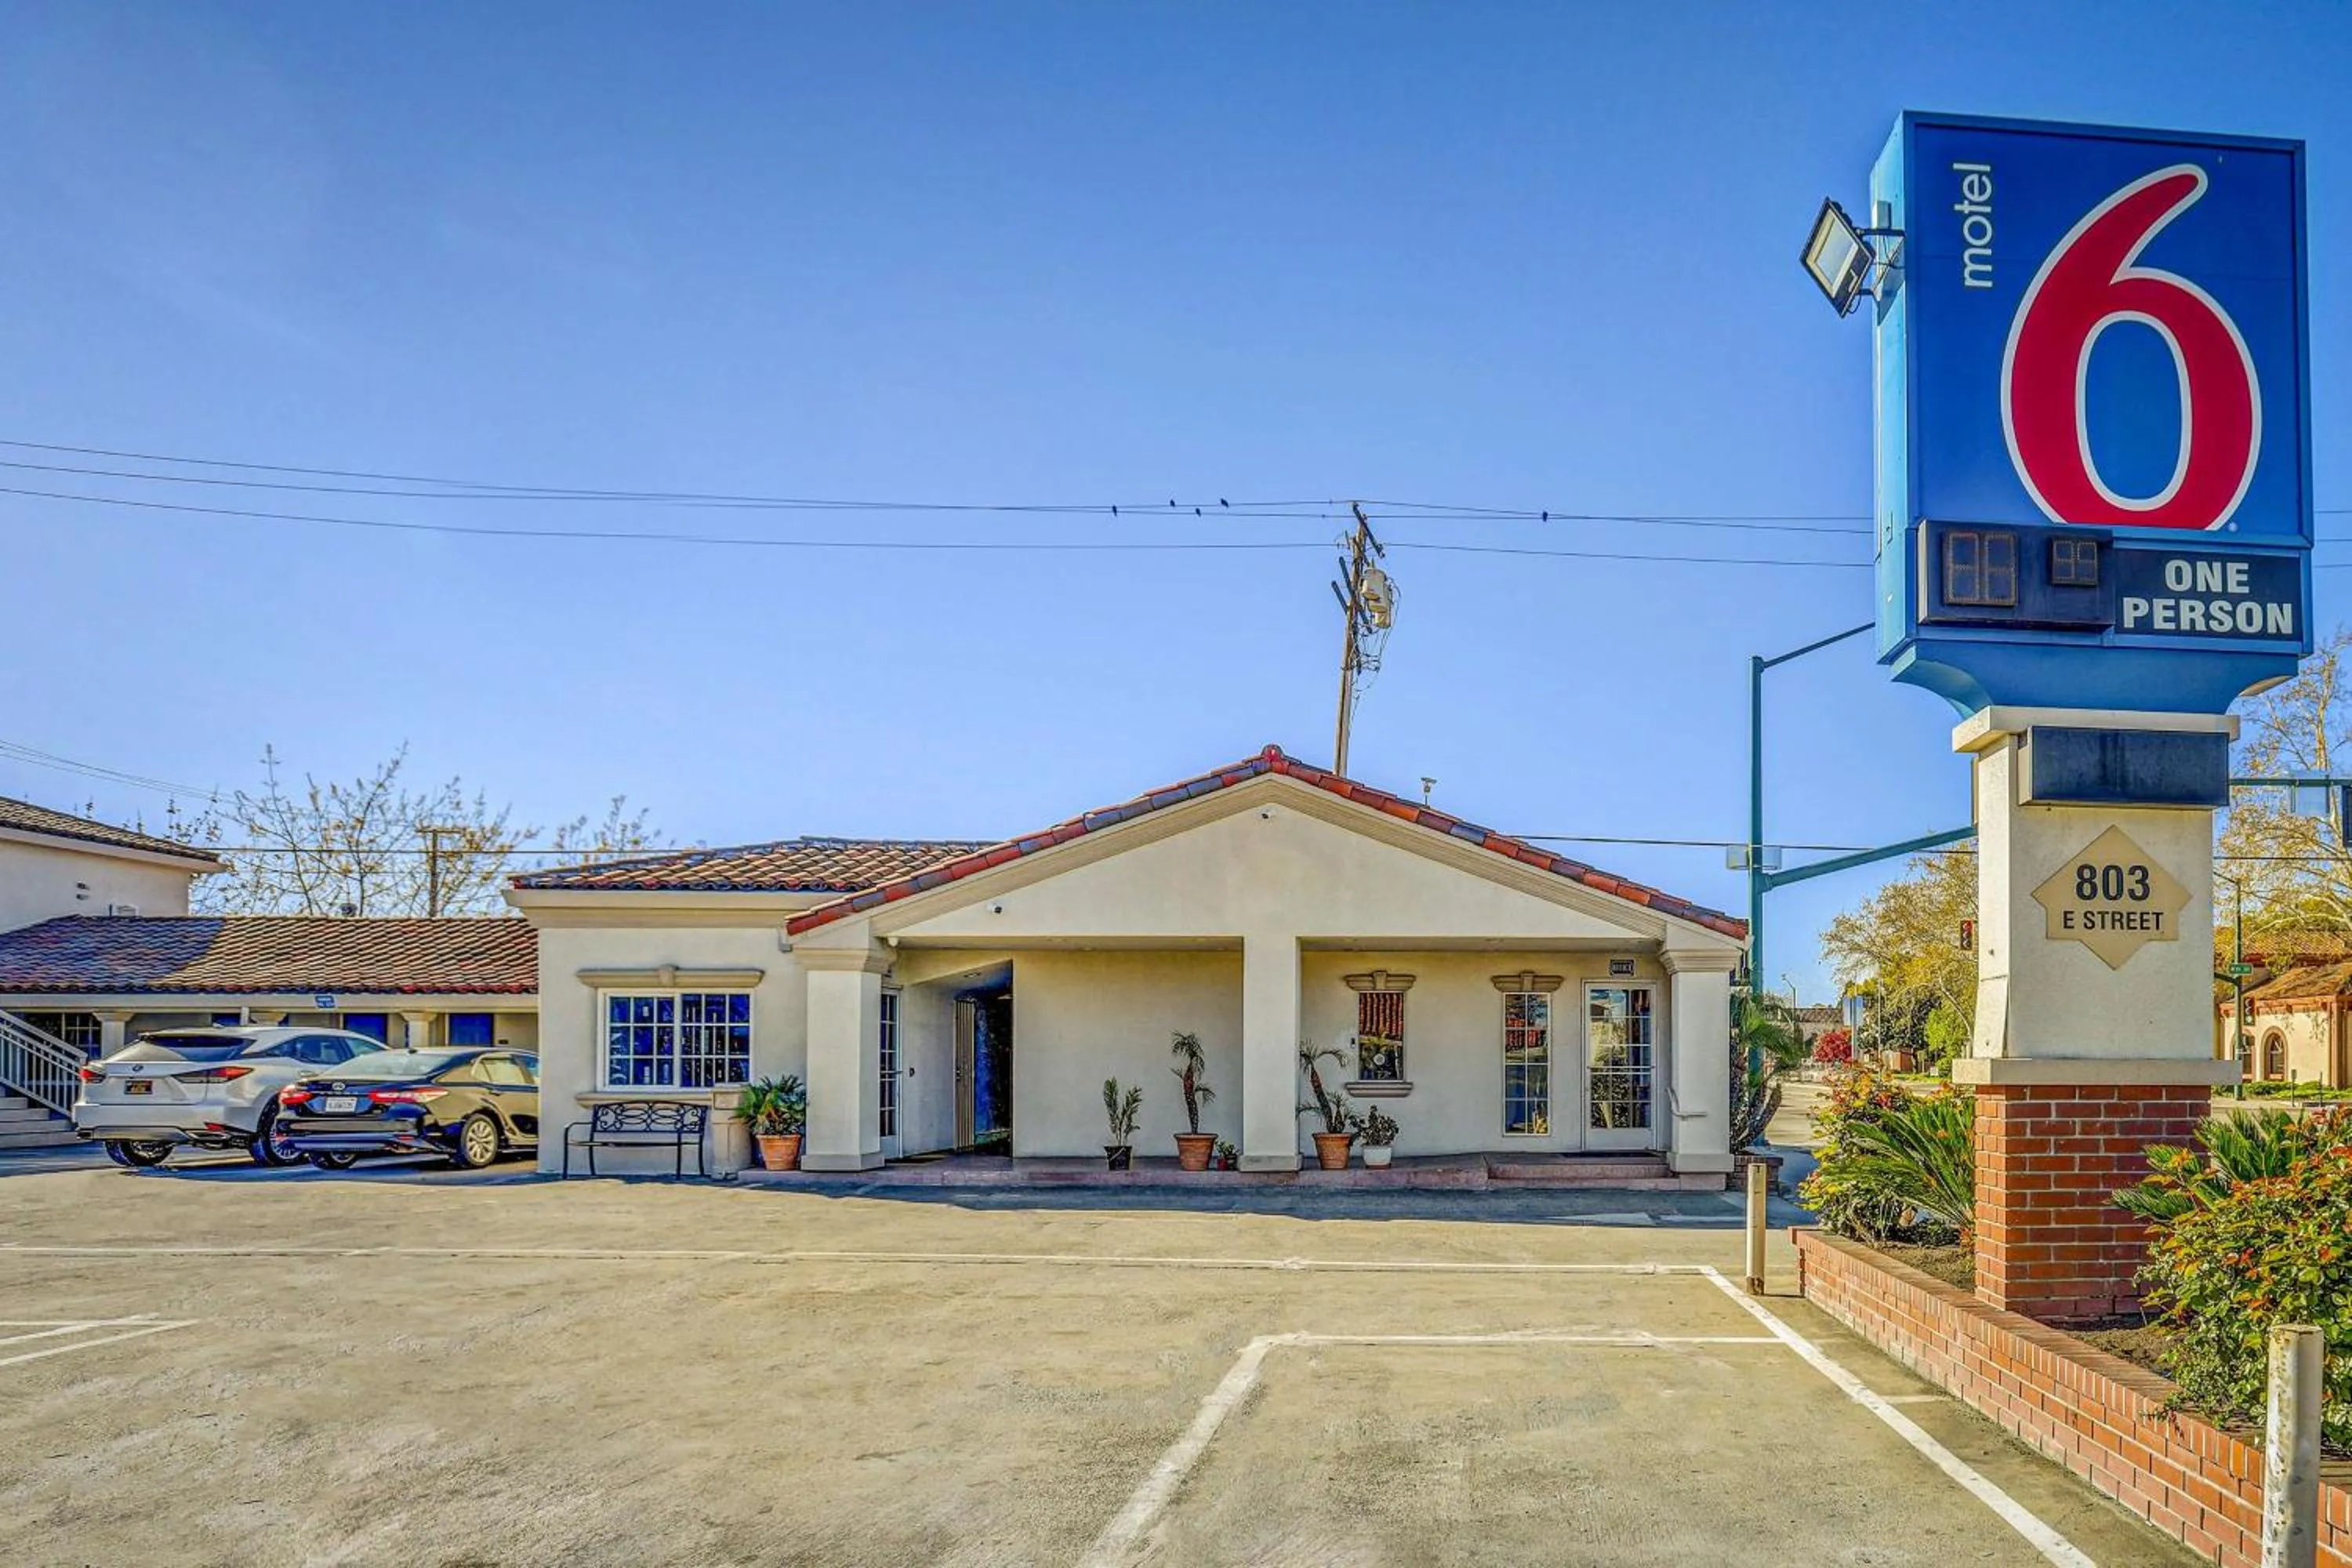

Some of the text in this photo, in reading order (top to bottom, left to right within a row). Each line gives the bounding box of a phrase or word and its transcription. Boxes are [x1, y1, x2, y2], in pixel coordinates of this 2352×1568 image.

[1953, 162, 1993, 288] motel
[2001, 163, 2262, 531] 6
[2165, 559, 2250, 593] ONE
[2122, 597, 2293, 634] PERSON
[2075, 863, 2151, 902] 803
[2063, 910, 2165, 931] E STREET
